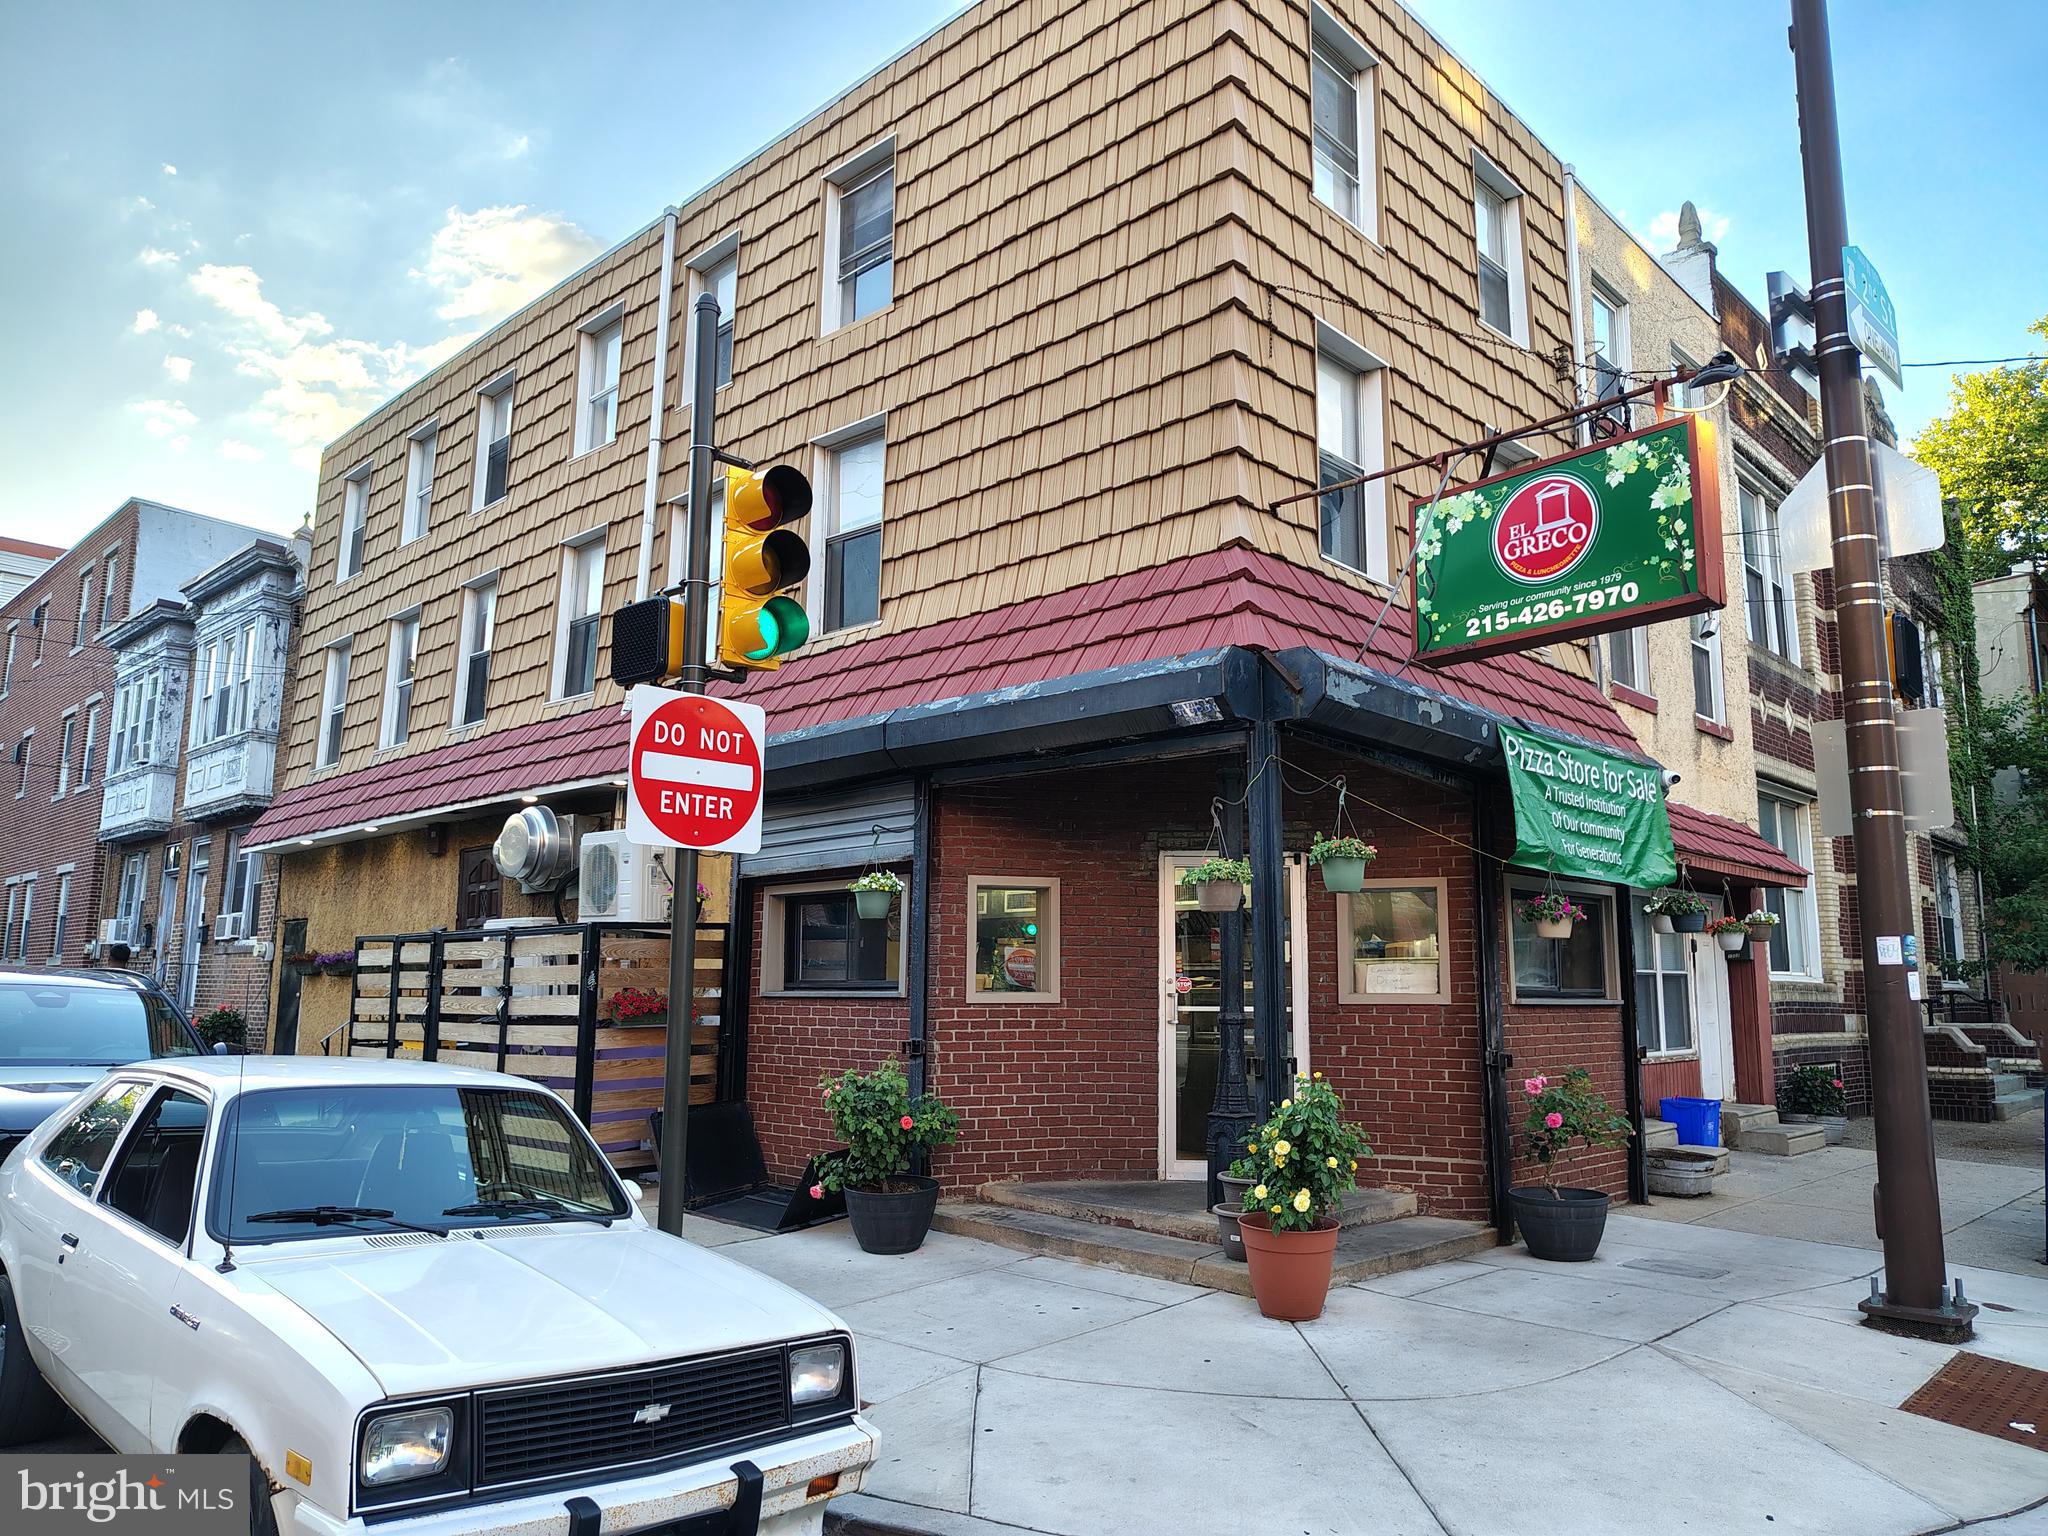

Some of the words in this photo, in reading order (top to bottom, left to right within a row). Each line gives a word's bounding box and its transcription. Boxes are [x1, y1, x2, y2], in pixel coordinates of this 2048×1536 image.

[1879, 295, 1896, 333] St
[1503, 522, 1588, 560] GRECO
[1509, 522, 1531, 541] EL
[1510, 560, 1527, 574] PIZZA
[1533, 543, 1582, 575] LUNCHEONETTE
[1478, 599, 1508, 613] Serving
[1510, 597, 1525, 606] our
[1525, 585, 1572, 603] community
[1573, 578, 1597, 591] since
[1599, 572, 1622, 585] 1979
[1465, 582, 1639, 638] 215-426-7970
[654, 720, 686, 746] DO
[700, 727, 744, 755] NOT
[1505, 736, 1554, 777] Pizza
[1557, 750, 1600, 788] Store
[1603, 761, 1624, 795] for
[1627, 770, 1657, 803] Sale
[660, 790, 733, 820] ENTER
[1545, 785, 1552, 801] A
[1553, 786, 1585, 807] Trusted
[1586, 795, 1626, 817] Institution
[1552, 811, 1563, 828] Of
[1564, 814, 1579, 832] Our
[1580, 820, 1625, 845] community
[1562, 838, 1575, 854] For
[1576, 843, 1622, 865] Generations
